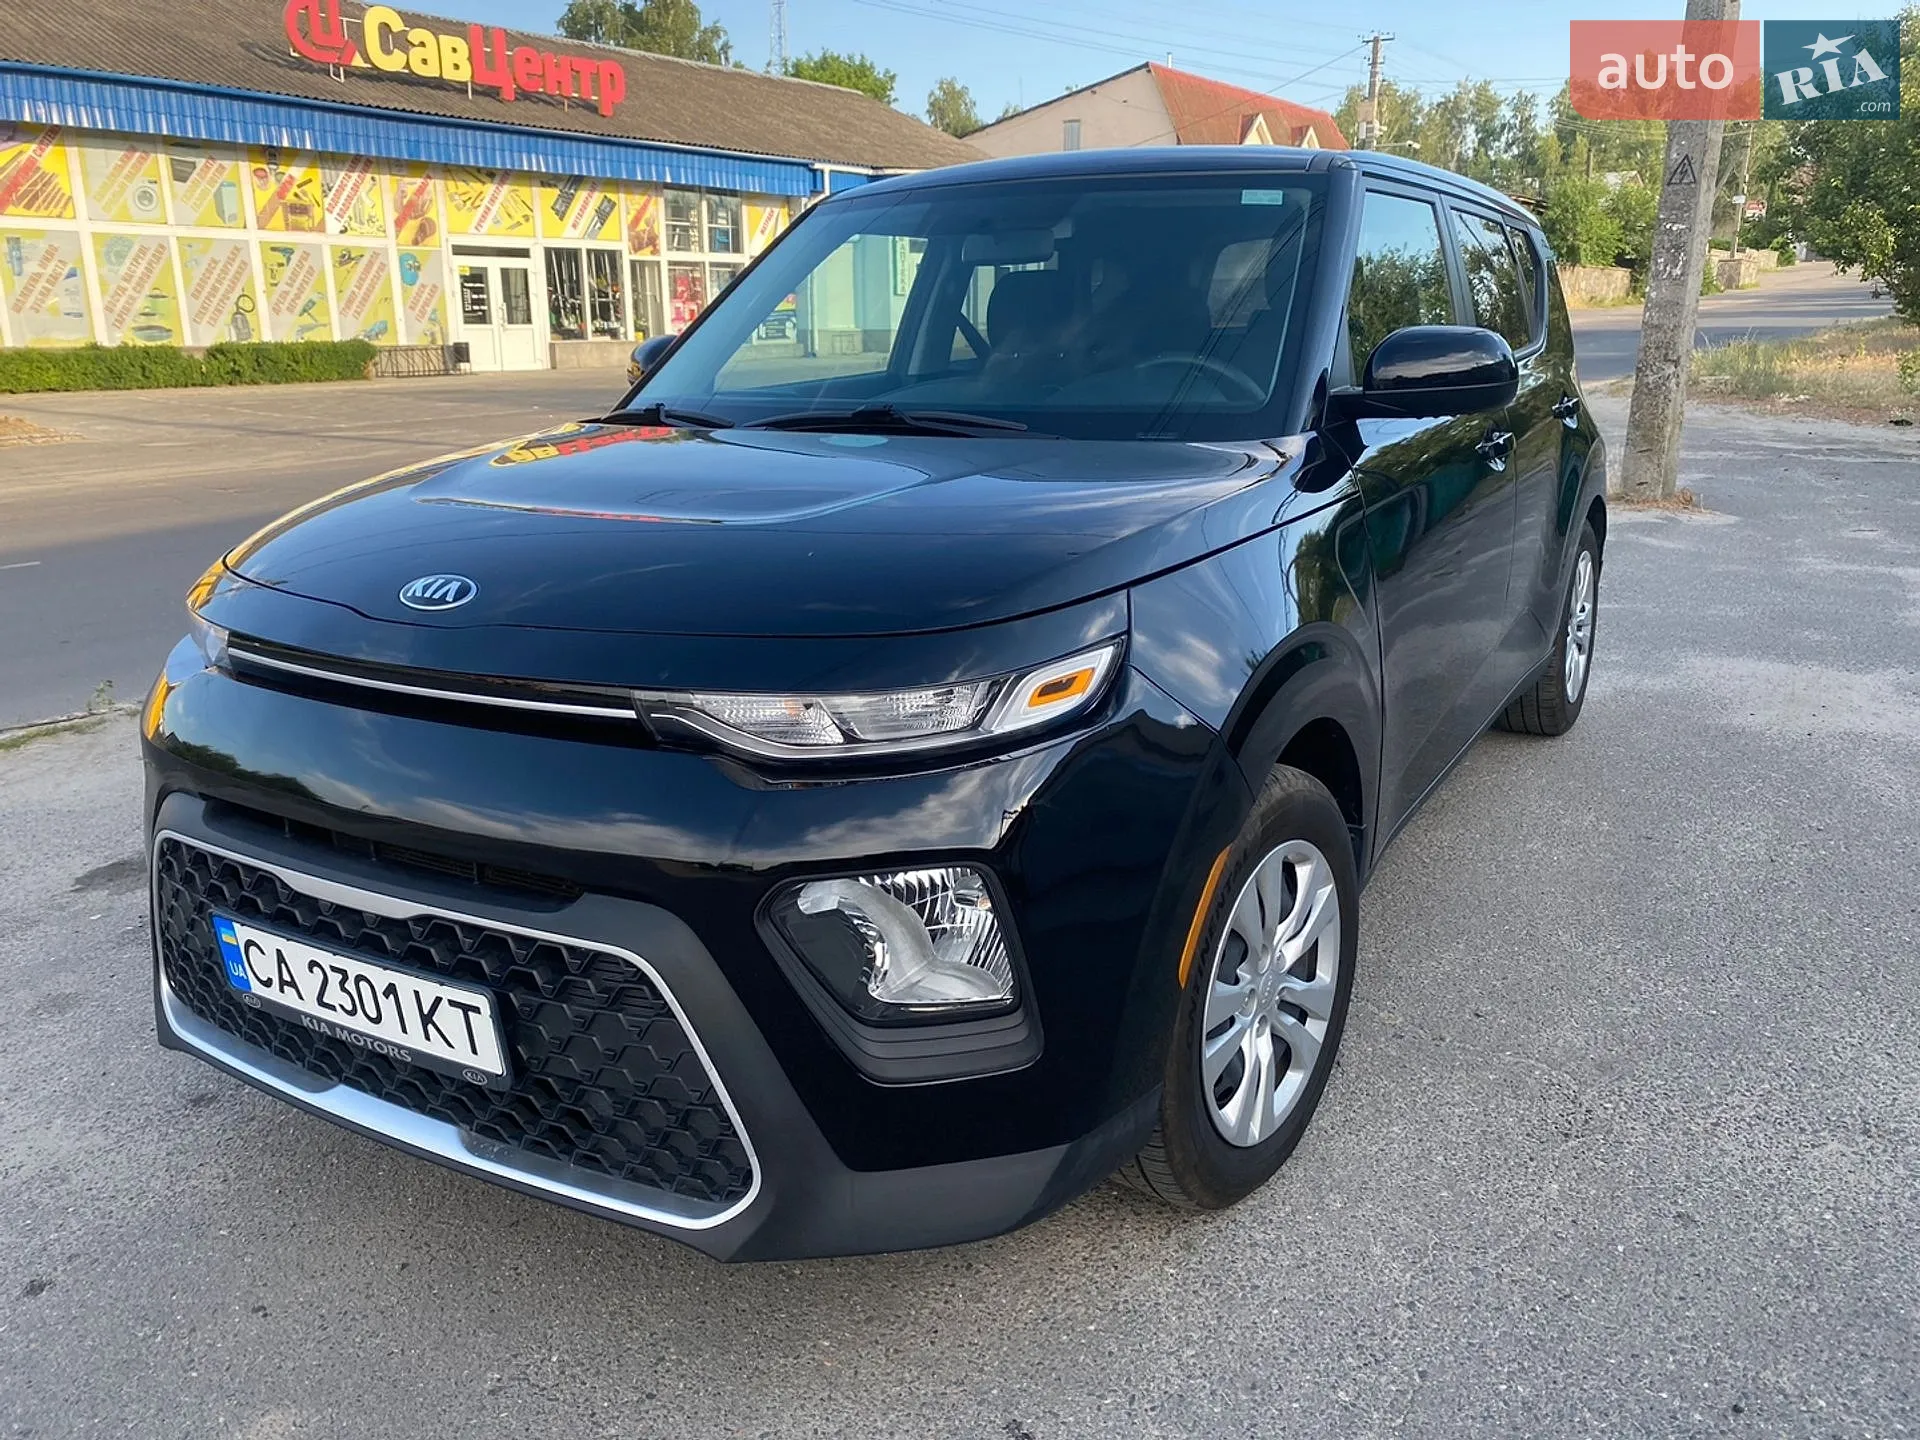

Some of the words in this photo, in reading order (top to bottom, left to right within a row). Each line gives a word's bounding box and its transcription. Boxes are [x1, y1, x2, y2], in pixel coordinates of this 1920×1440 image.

[363, 5, 626, 117] СавЦентр
[406, 577, 462, 602] KIA
[229, 960, 249, 981] UA
[244, 938, 305, 1002] CA
[307, 959, 409, 1035] 2301
[413, 989, 482, 1056] KT
[300, 1014, 332, 1037] KIA
[334, 1028, 413, 1064] MOTORS
